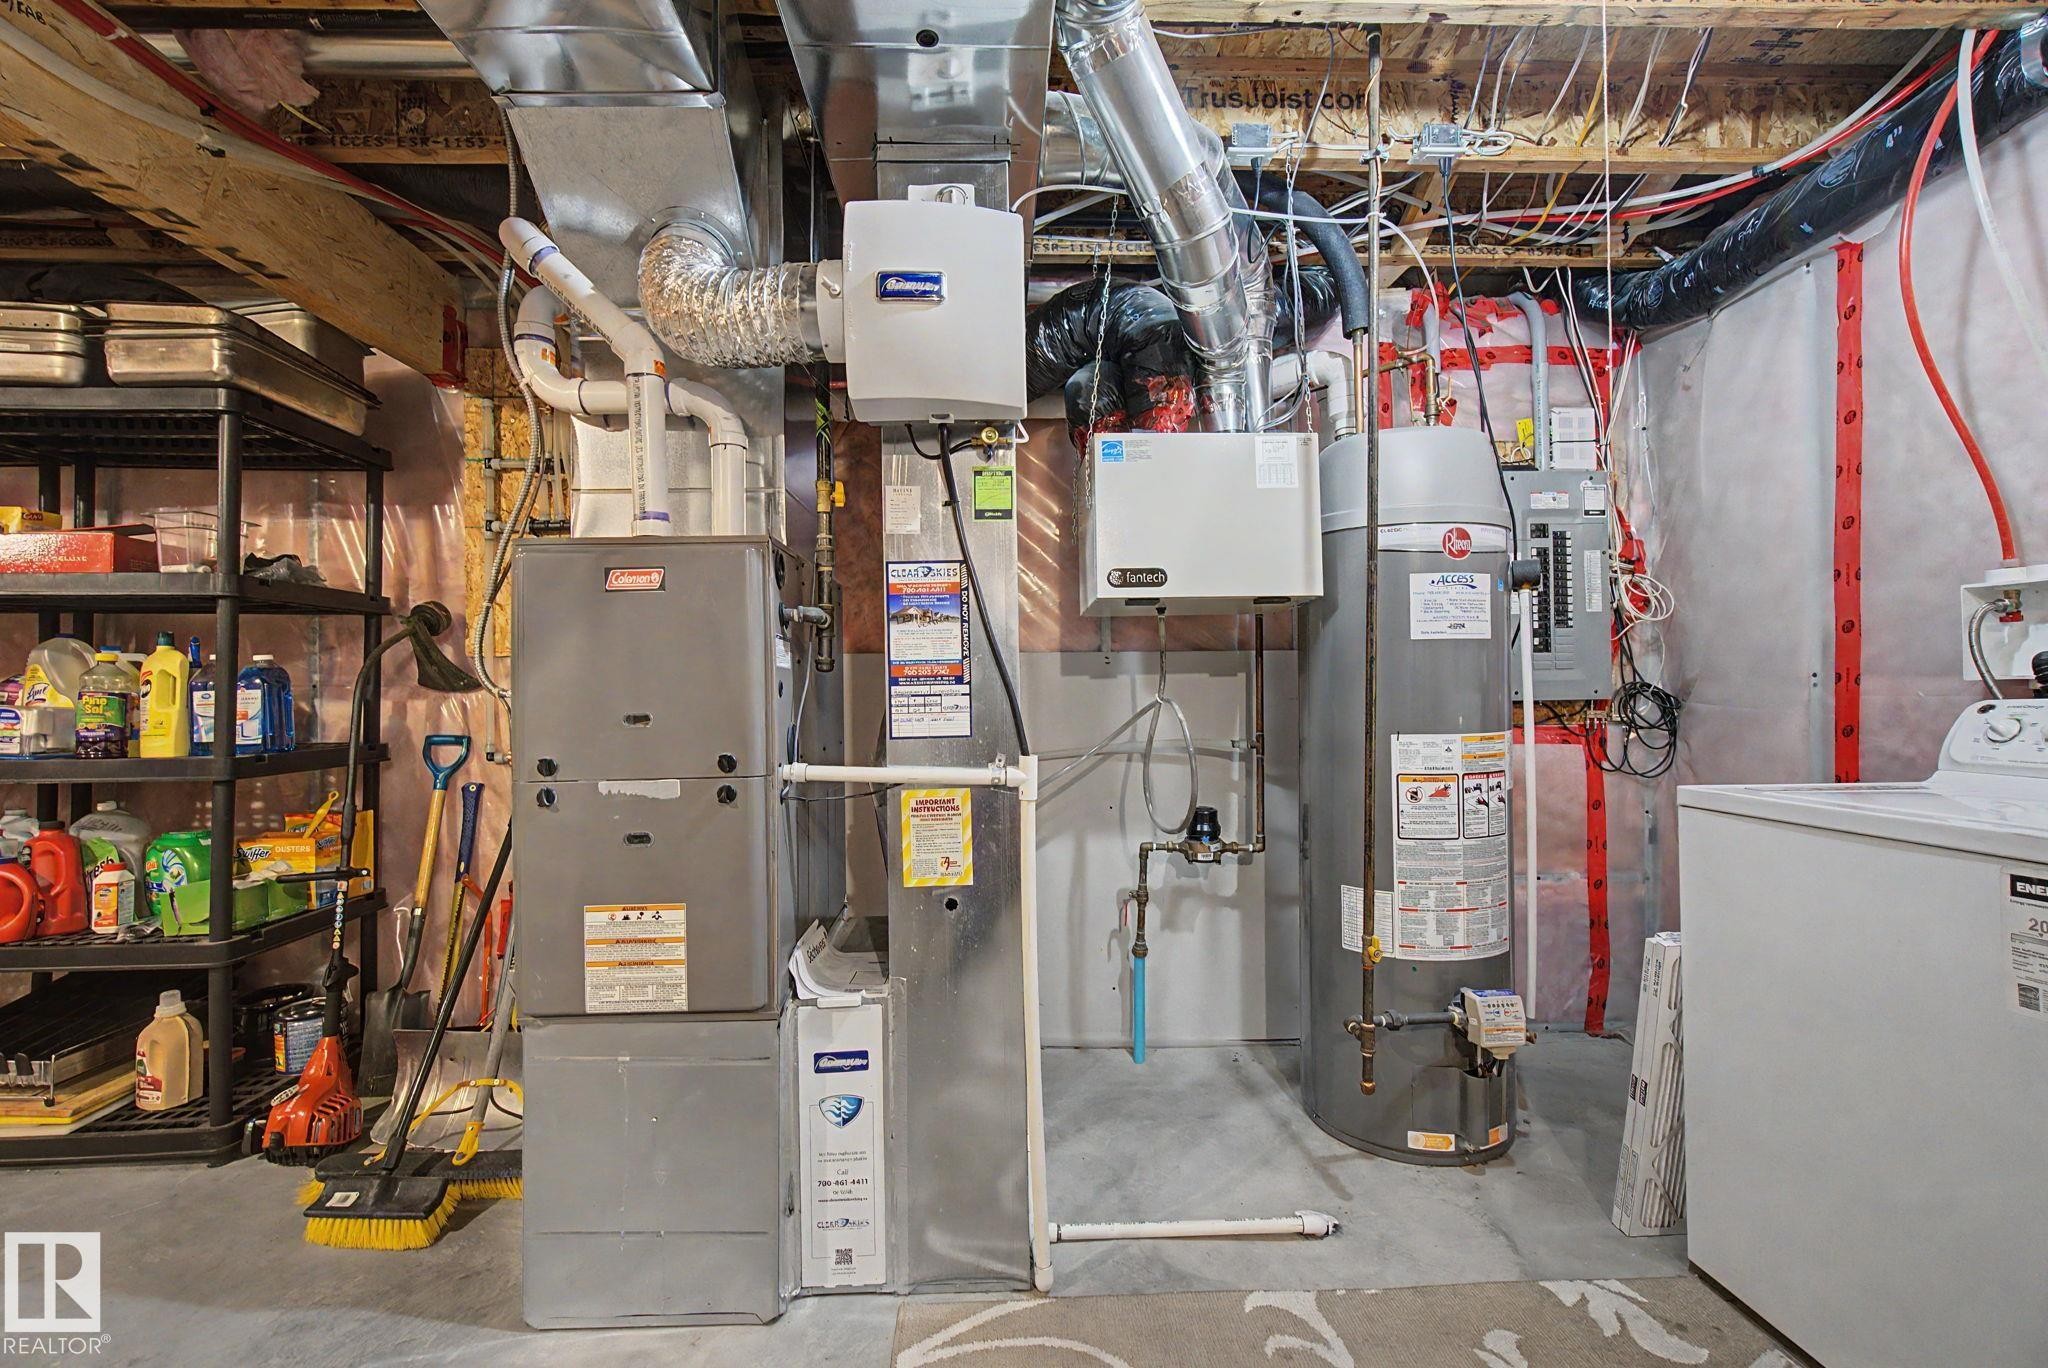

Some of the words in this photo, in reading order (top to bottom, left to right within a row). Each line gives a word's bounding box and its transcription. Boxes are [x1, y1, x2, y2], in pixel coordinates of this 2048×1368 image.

[1446, 528, 1471, 555] Rheem
[1126, 571, 1165, 583] fantech
[962, 604, 970, 621] NOT
[911, 805, 960, 813] INSTRUCTIONS
[915, 798, 955, 806] IMPORTANT
[2016, 881, 2048, 897] ENE
